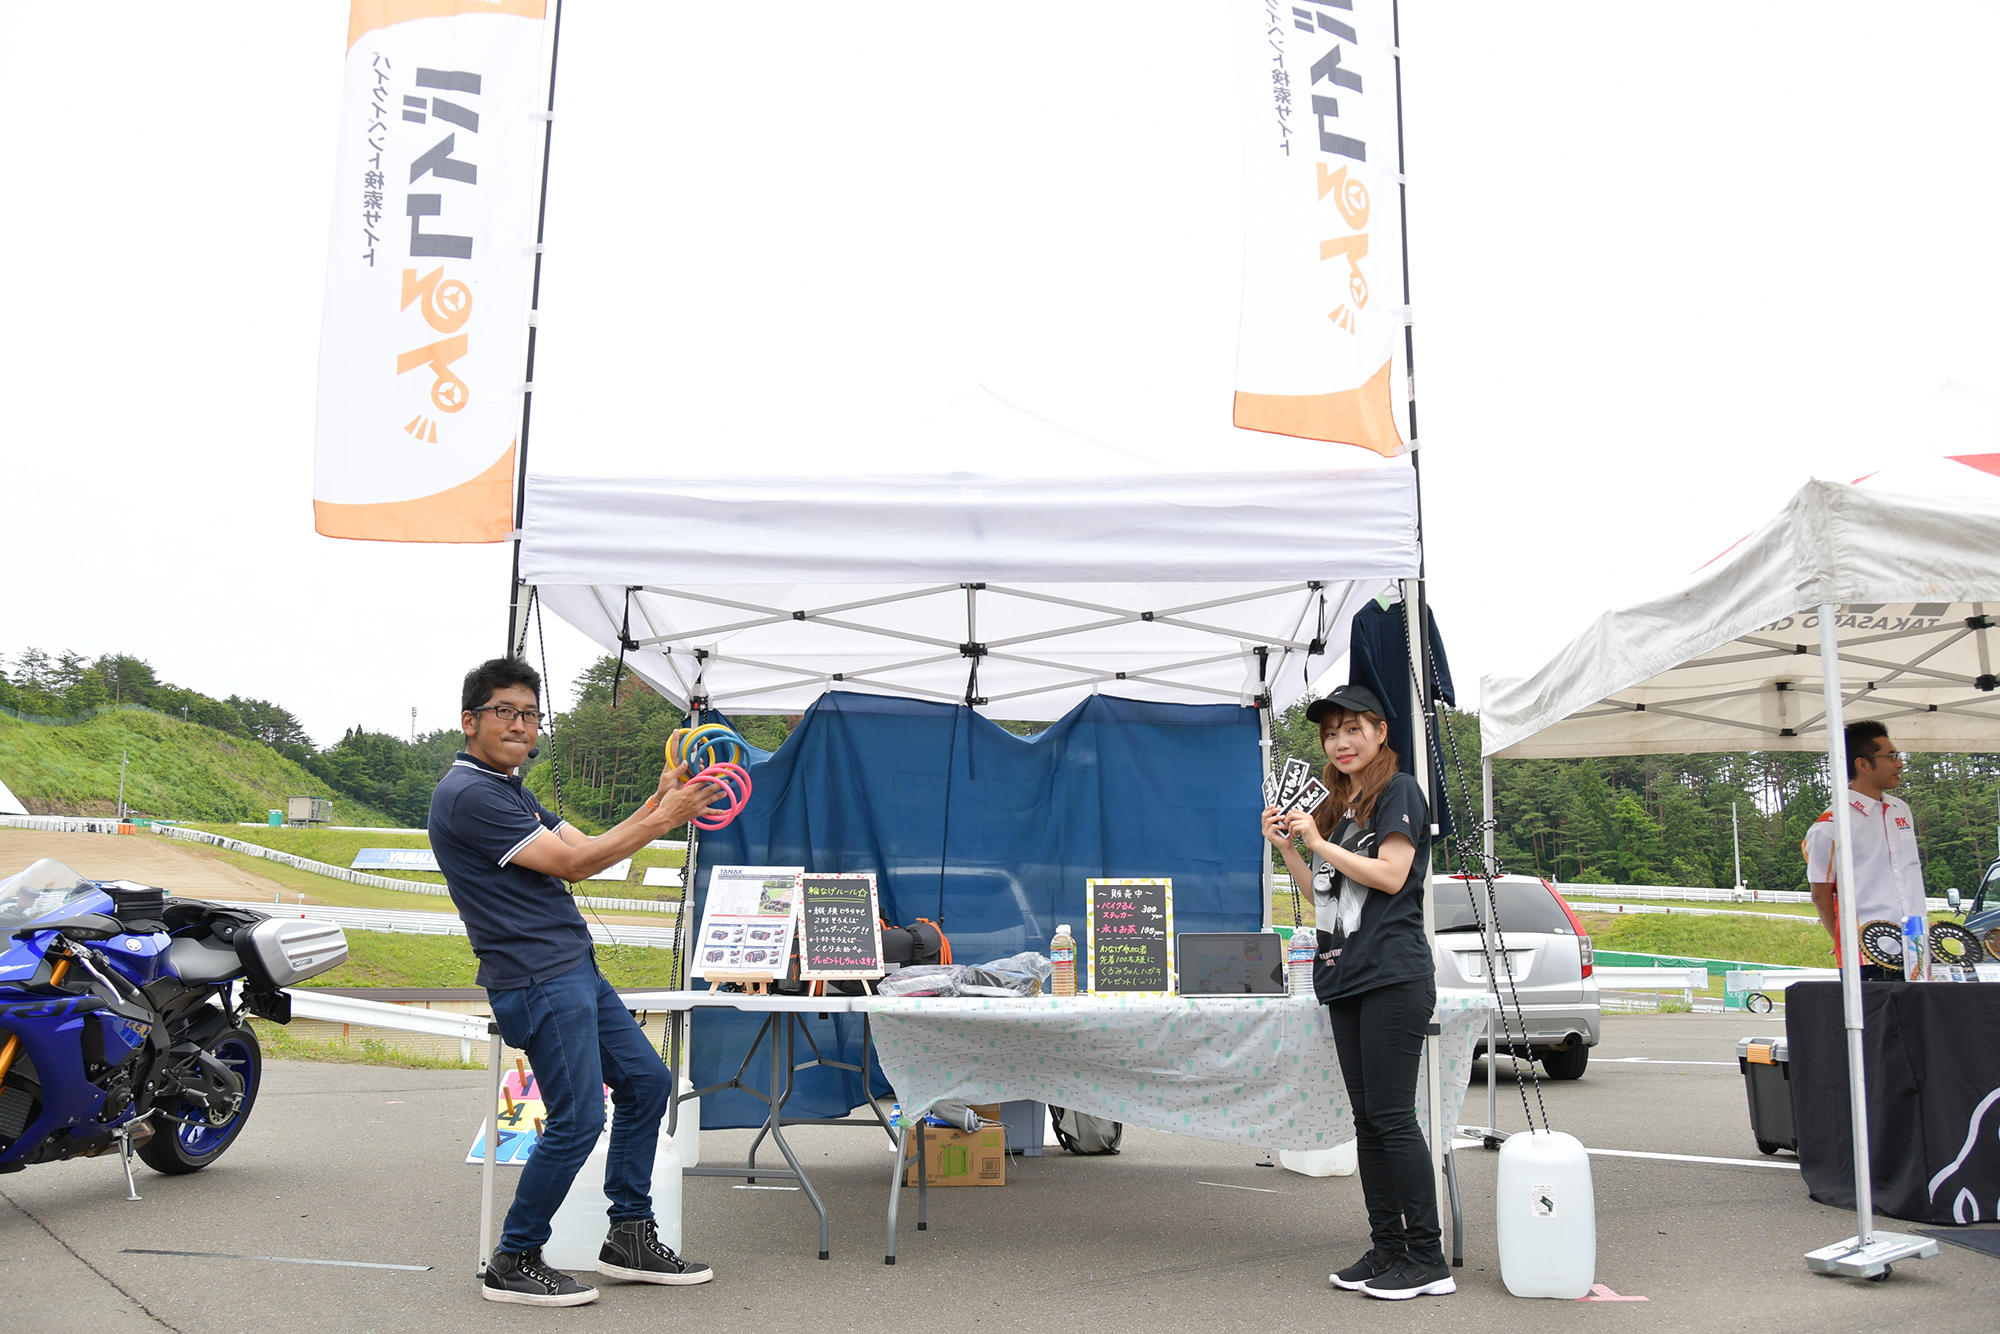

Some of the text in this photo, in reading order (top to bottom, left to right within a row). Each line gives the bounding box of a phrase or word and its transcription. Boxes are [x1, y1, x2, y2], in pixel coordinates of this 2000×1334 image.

[1894, 817, 1910, 827] RK
[1141, 905, 1157, 913] 300
[498, 1103, 527, 1126] 4
